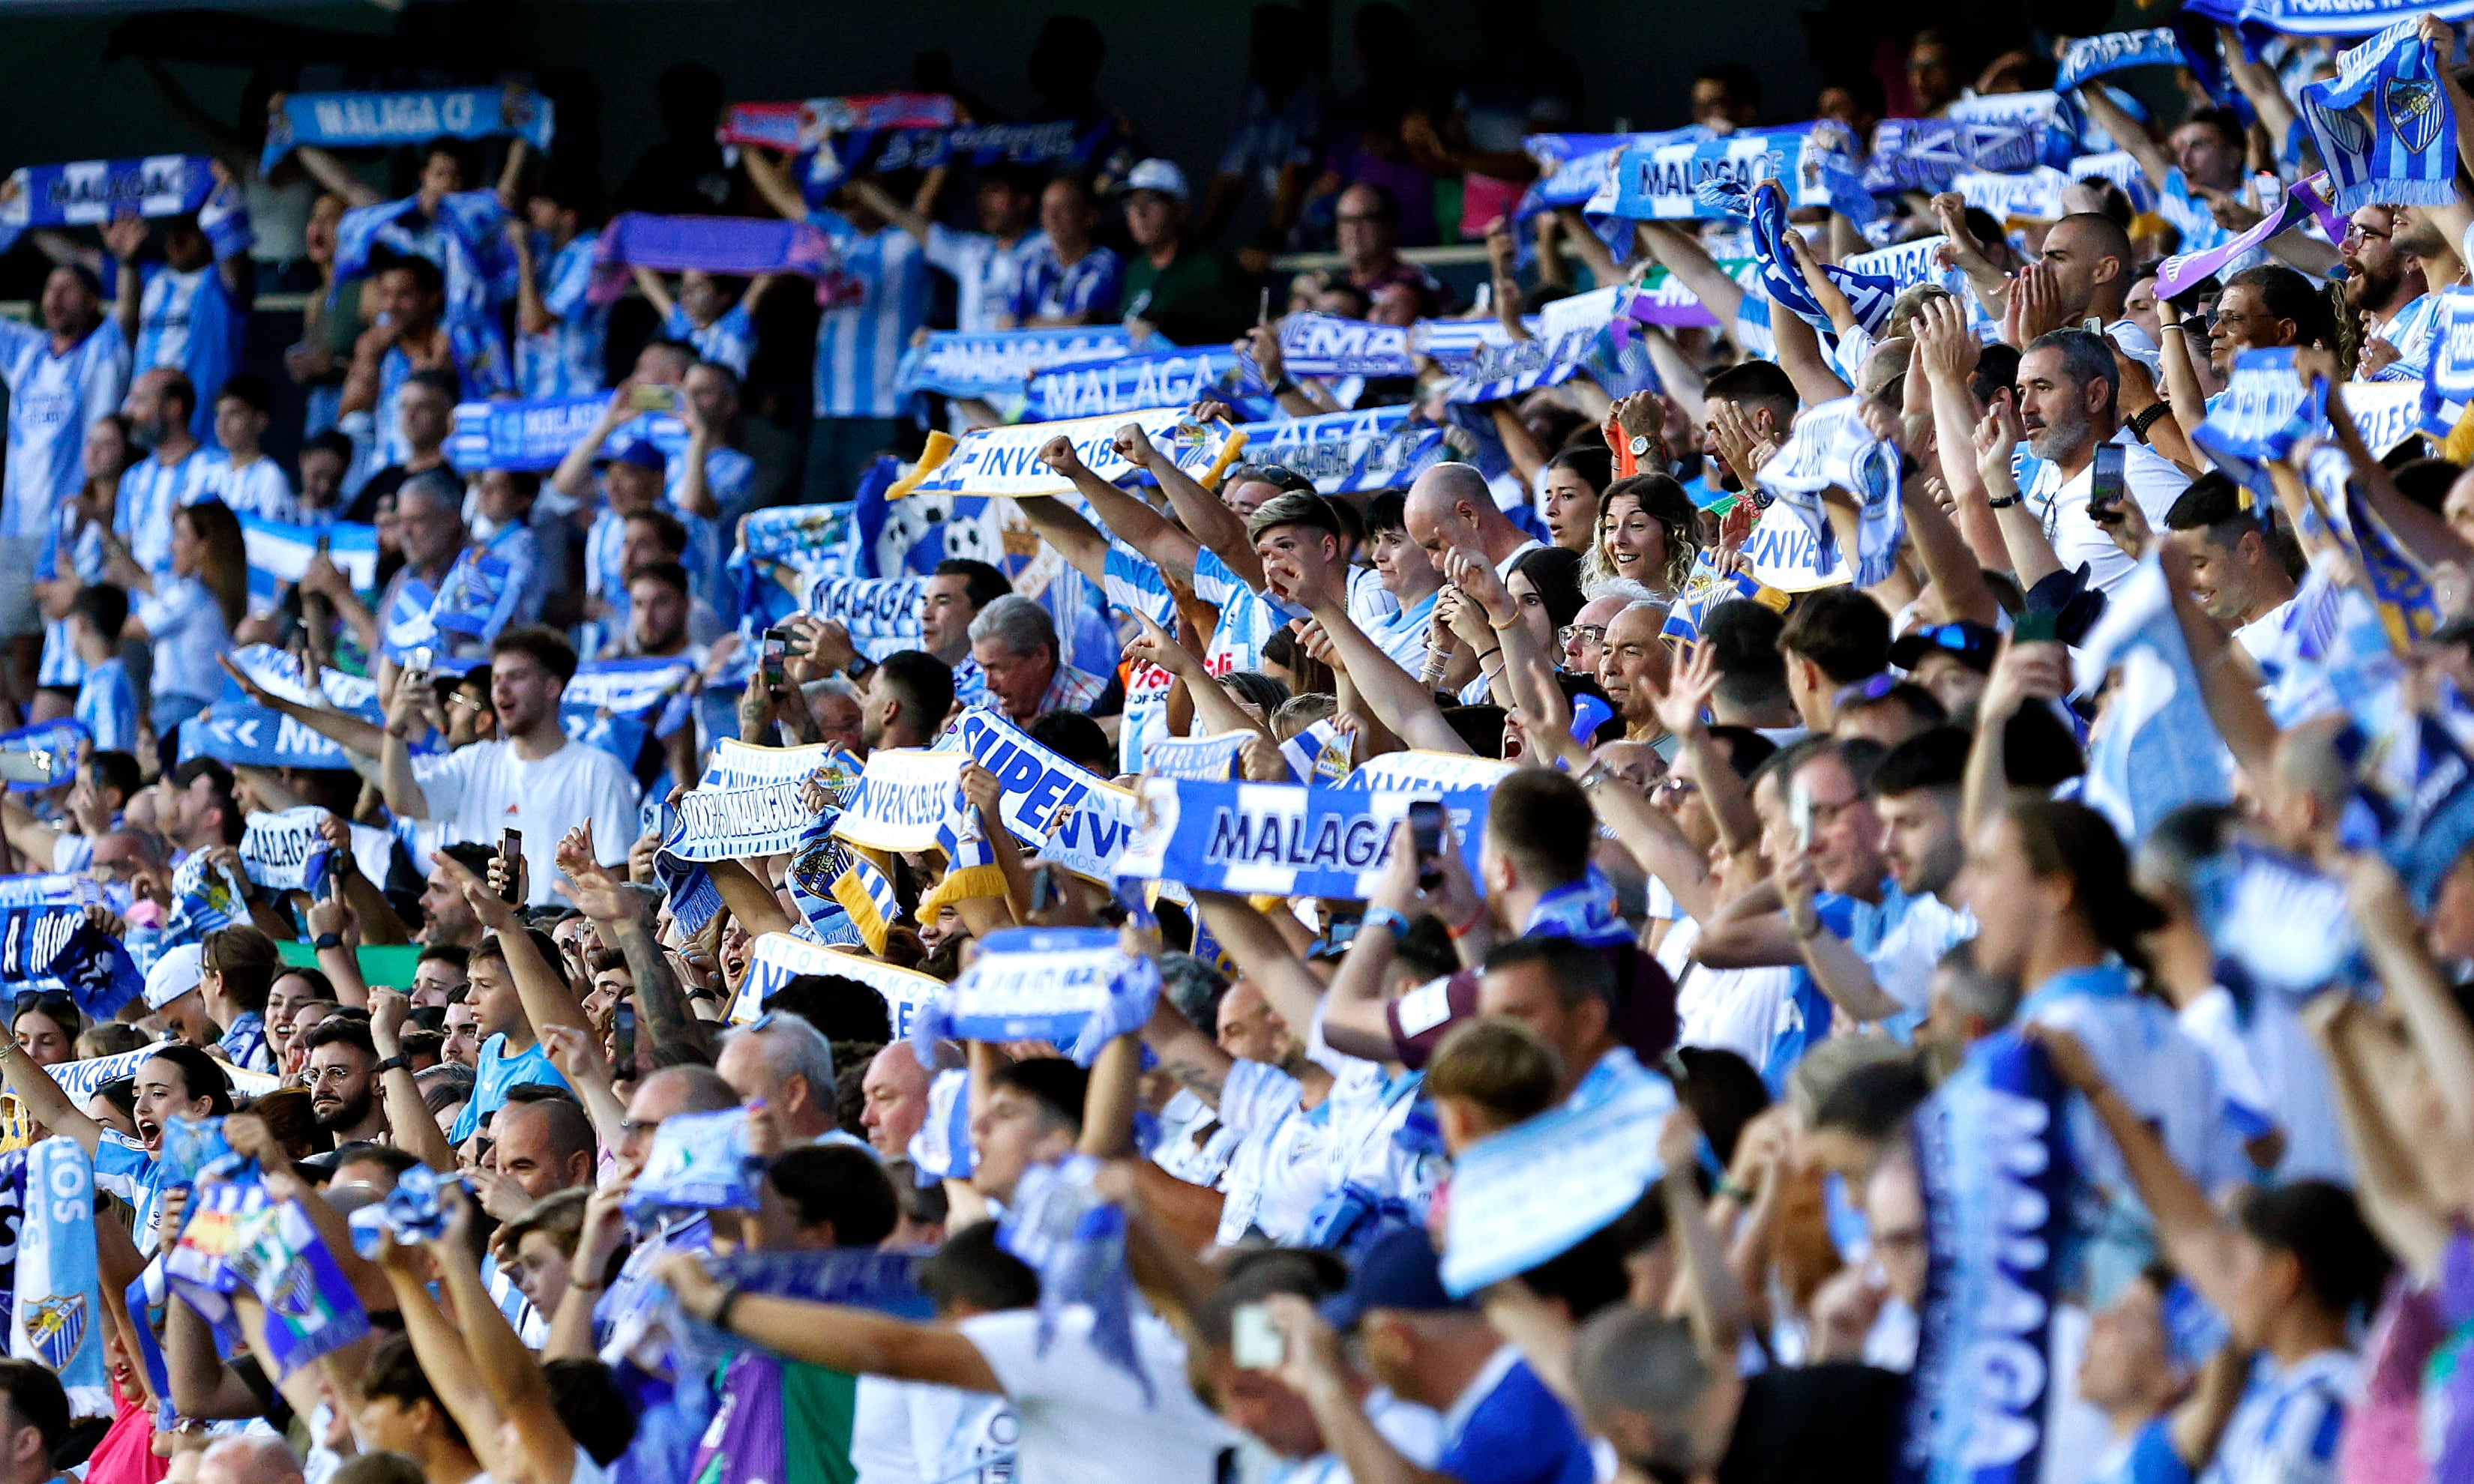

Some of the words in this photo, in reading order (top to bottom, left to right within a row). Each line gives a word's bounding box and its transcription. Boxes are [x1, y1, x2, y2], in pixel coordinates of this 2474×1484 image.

[315, 95, 439, 135] MALAGA
[1042, 355, 1215, 418] MALAGA
[812, 576, 922, 621] MALAGA
[681, 791, 729, 841] 100%
